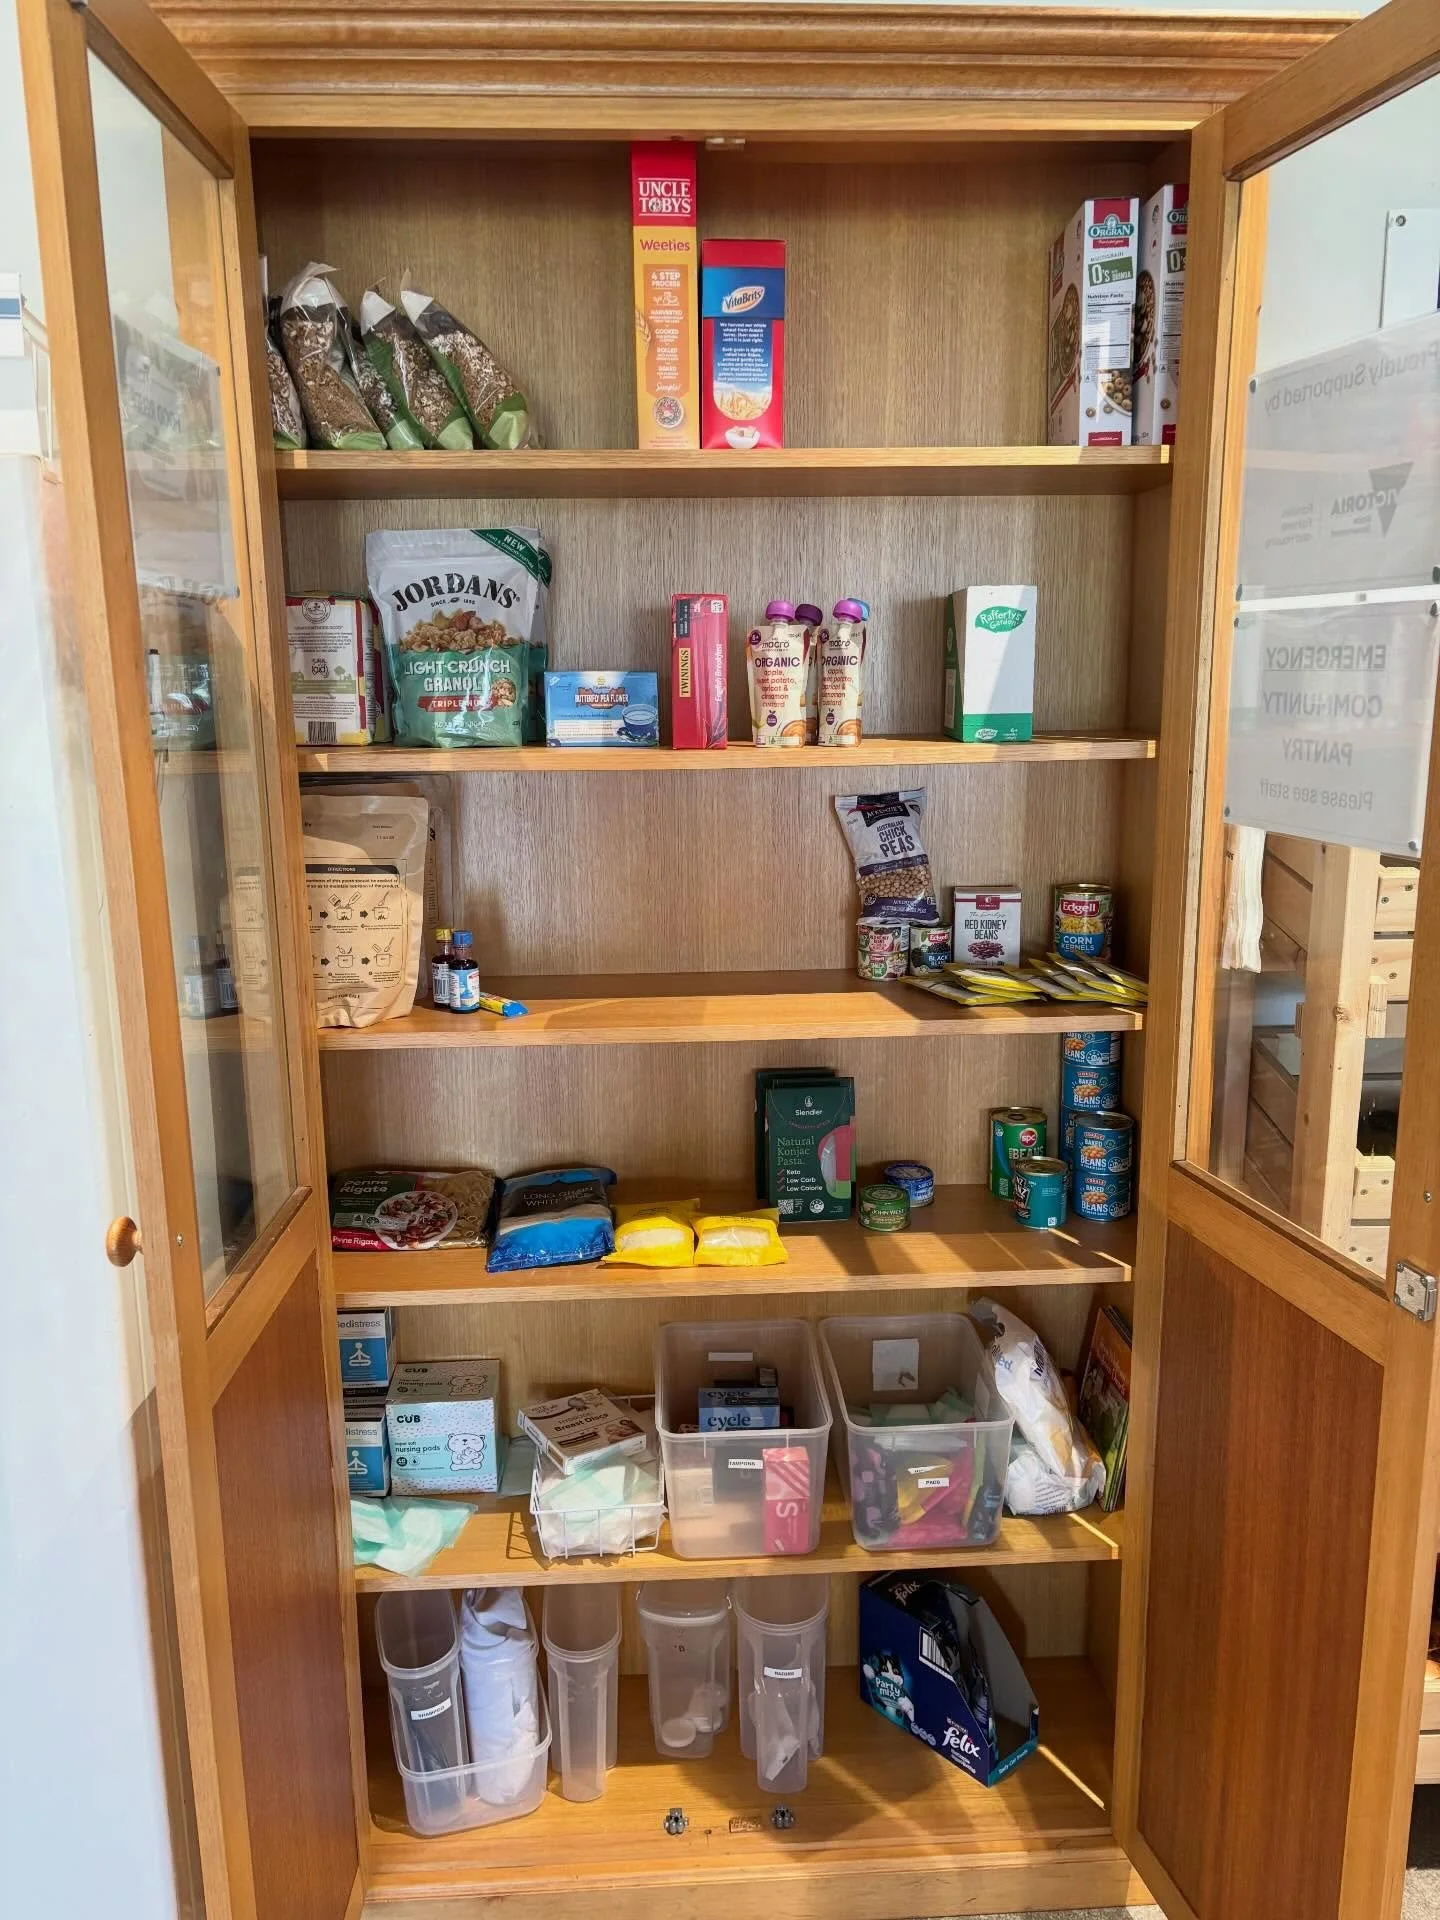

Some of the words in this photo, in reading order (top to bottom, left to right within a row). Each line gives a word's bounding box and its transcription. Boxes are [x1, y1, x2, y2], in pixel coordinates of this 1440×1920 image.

[639, 181, 691, 197] UNCLE
[639, 197, 692, 213] TOBYS
[1090, 224, 1131, 237] ORGRAN
[640, 240, 690, 250] Weeties
[659, 272, 680, 280] STEP
[504, 534, 526, 552] NEW
[392, 573, 517, 612] JORDANS
[430, 599, 446, 608] SINCE
[990, 618, 1016, 629] Garden
[762, 640, 790, 648] macro
[714, 644, 724, 676] Breakfast
[754, 657, 800, 668] ORGANIC
[404, 661, 445, 676] LIGHT
[447, 659, 511, 674] CRUNCH
[681, 650, 689, 696] TWININGS
[770, 677, 796, 685] potato,
[714, 677, 724, 702] English
[432, 700, 461, 708] TRIPLE
[600, 694, 610, 702] PEA
[878, 825, 908, 842] CHICK
[880, 835, 915, 858] PEAS
[1062, 901, 1096, 914] Edgell
[964, 920, 978, 929] RED
[980, 920, 1007, 930] KIDNEY
[975, 930, 998, 940] BEANS
[1063, 936, 1092, 944] CORN
[1074, 1094, 1100, 1105] BEANS
[777, 1136, 815, 1147] Natural
[1084, 1139, 1102, 1147] BAKED
[777, 1148, 810, 1157] Konjac
[1012, 1146, 1044, 1160] BEANS
[1080, 1156, 1107, 1168] BEANS
[340, 1186, 388, 1194] Rigate
[1082, 1200, 1108, 1212] BEANS
[336, 1319, 381, 1329] edistress
[396, 1414, 420, 1423] CUB
[555, 1420, 584, 1432] Breast
[584, 1413, 609, 1423] Discs
[708, 1413, 751, 1429] cycle
[876, 1677, 900, 1696] Party
[880, 1687, 896, 1699] mix
[942, 1727, 980, 1757] felix
